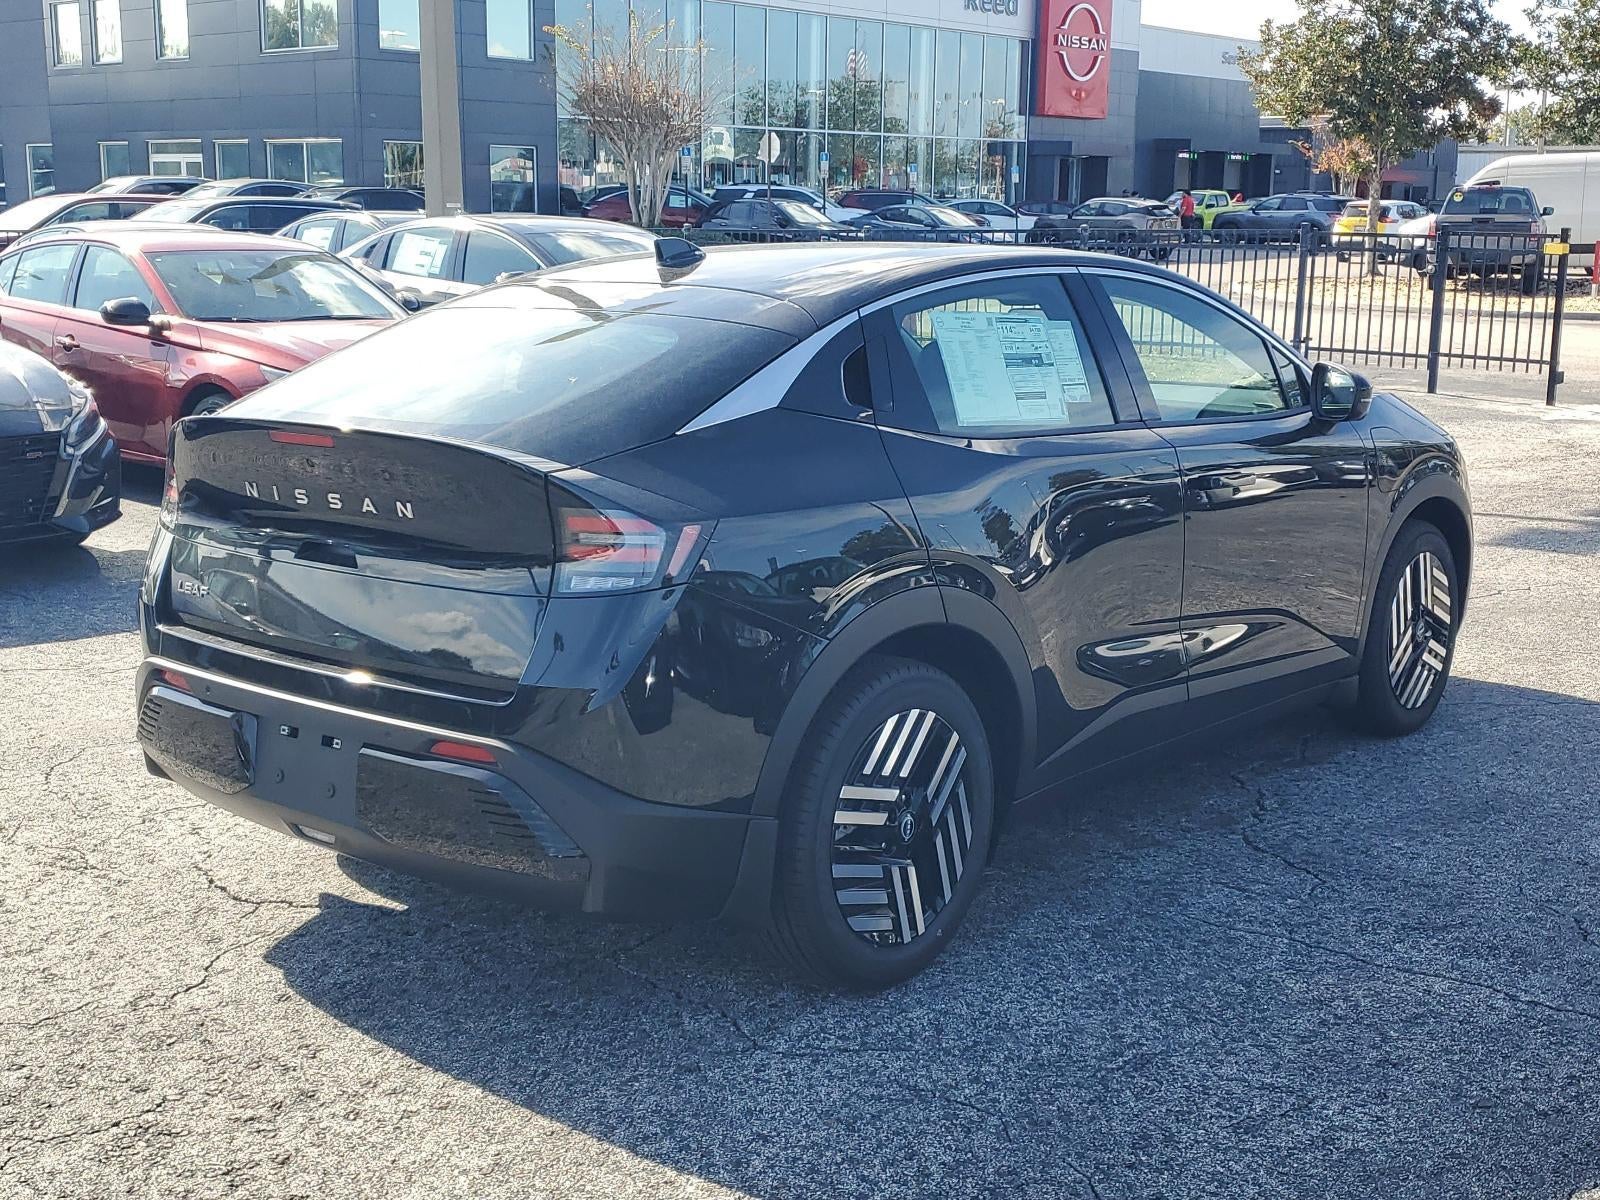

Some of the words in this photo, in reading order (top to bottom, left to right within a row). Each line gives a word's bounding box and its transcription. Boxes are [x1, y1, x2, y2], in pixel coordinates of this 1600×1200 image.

[1058, 33, 1107, 51] NISSAN
[244, 481, 414, 519] NISSAN
[177, 579, 209, 598] LEAF
